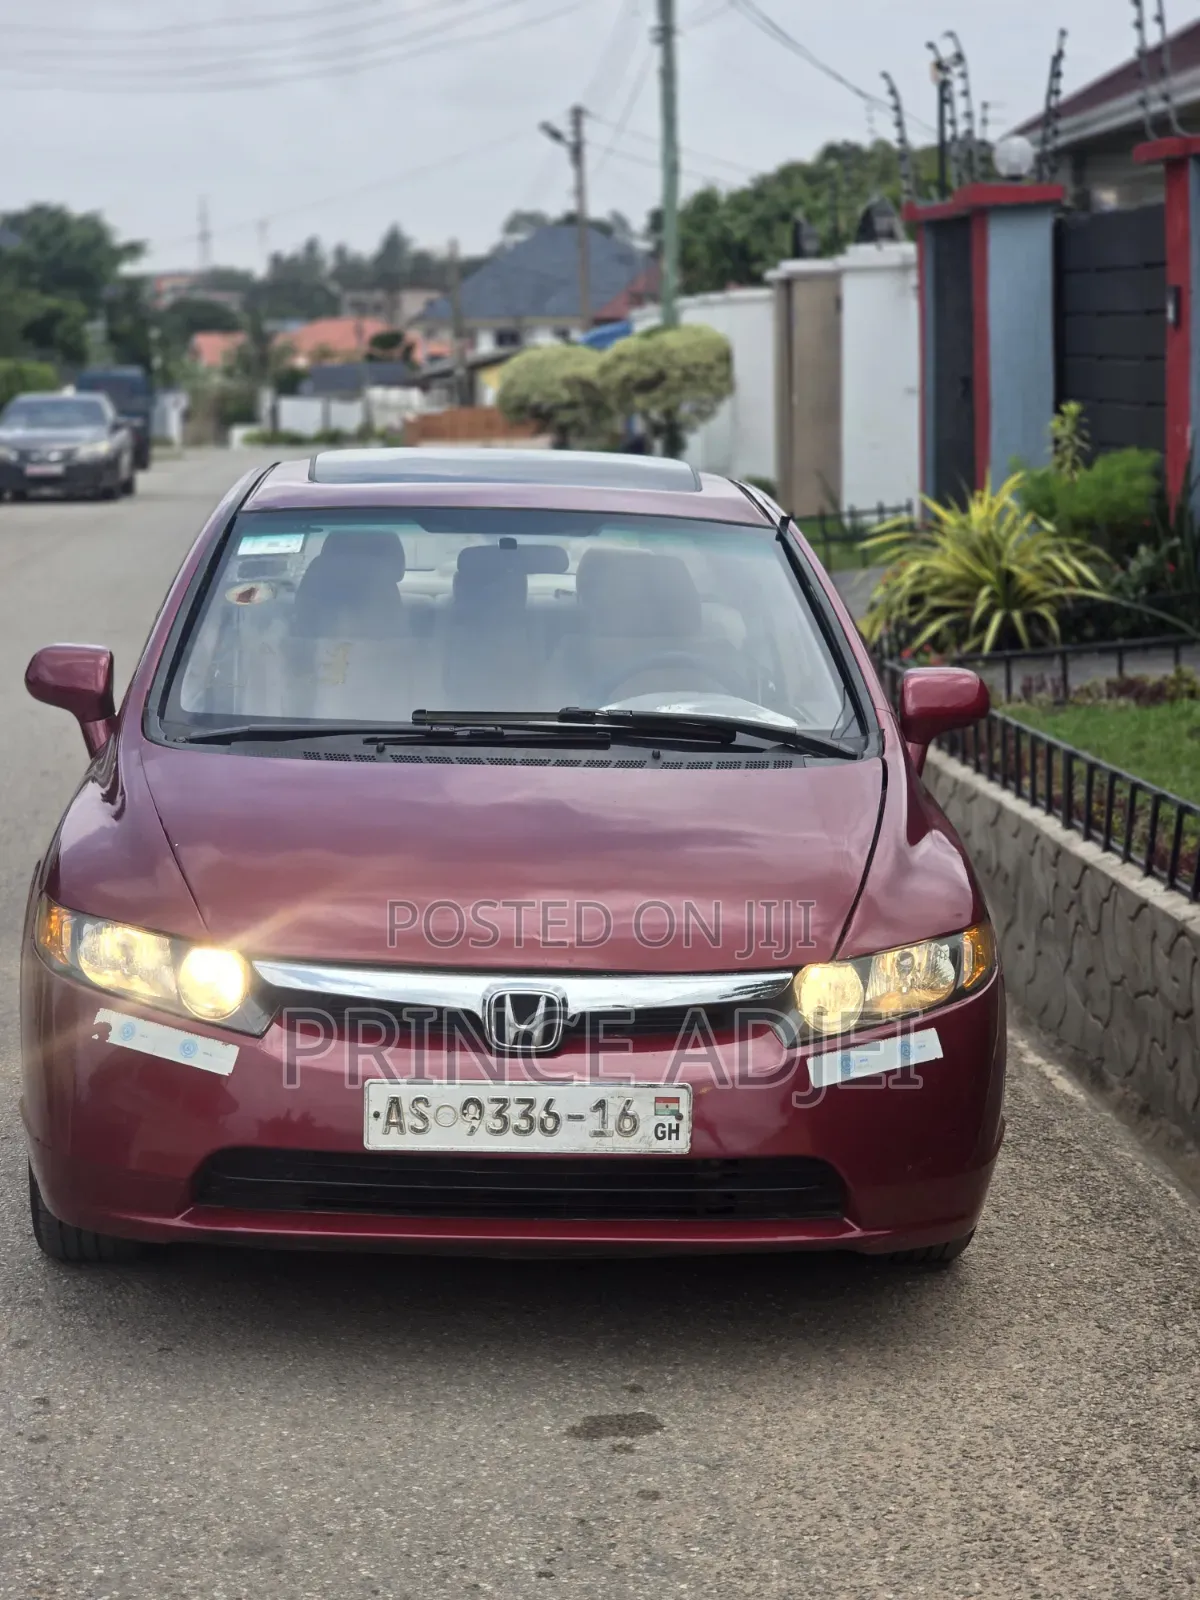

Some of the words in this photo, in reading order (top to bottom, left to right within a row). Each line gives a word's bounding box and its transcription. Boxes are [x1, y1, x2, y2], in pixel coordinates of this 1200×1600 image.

[382, 1094, 432, 1135] AS
[460, 1096, 640, 1137] 9336-16
[654, 1122, 680, 1141] GH
